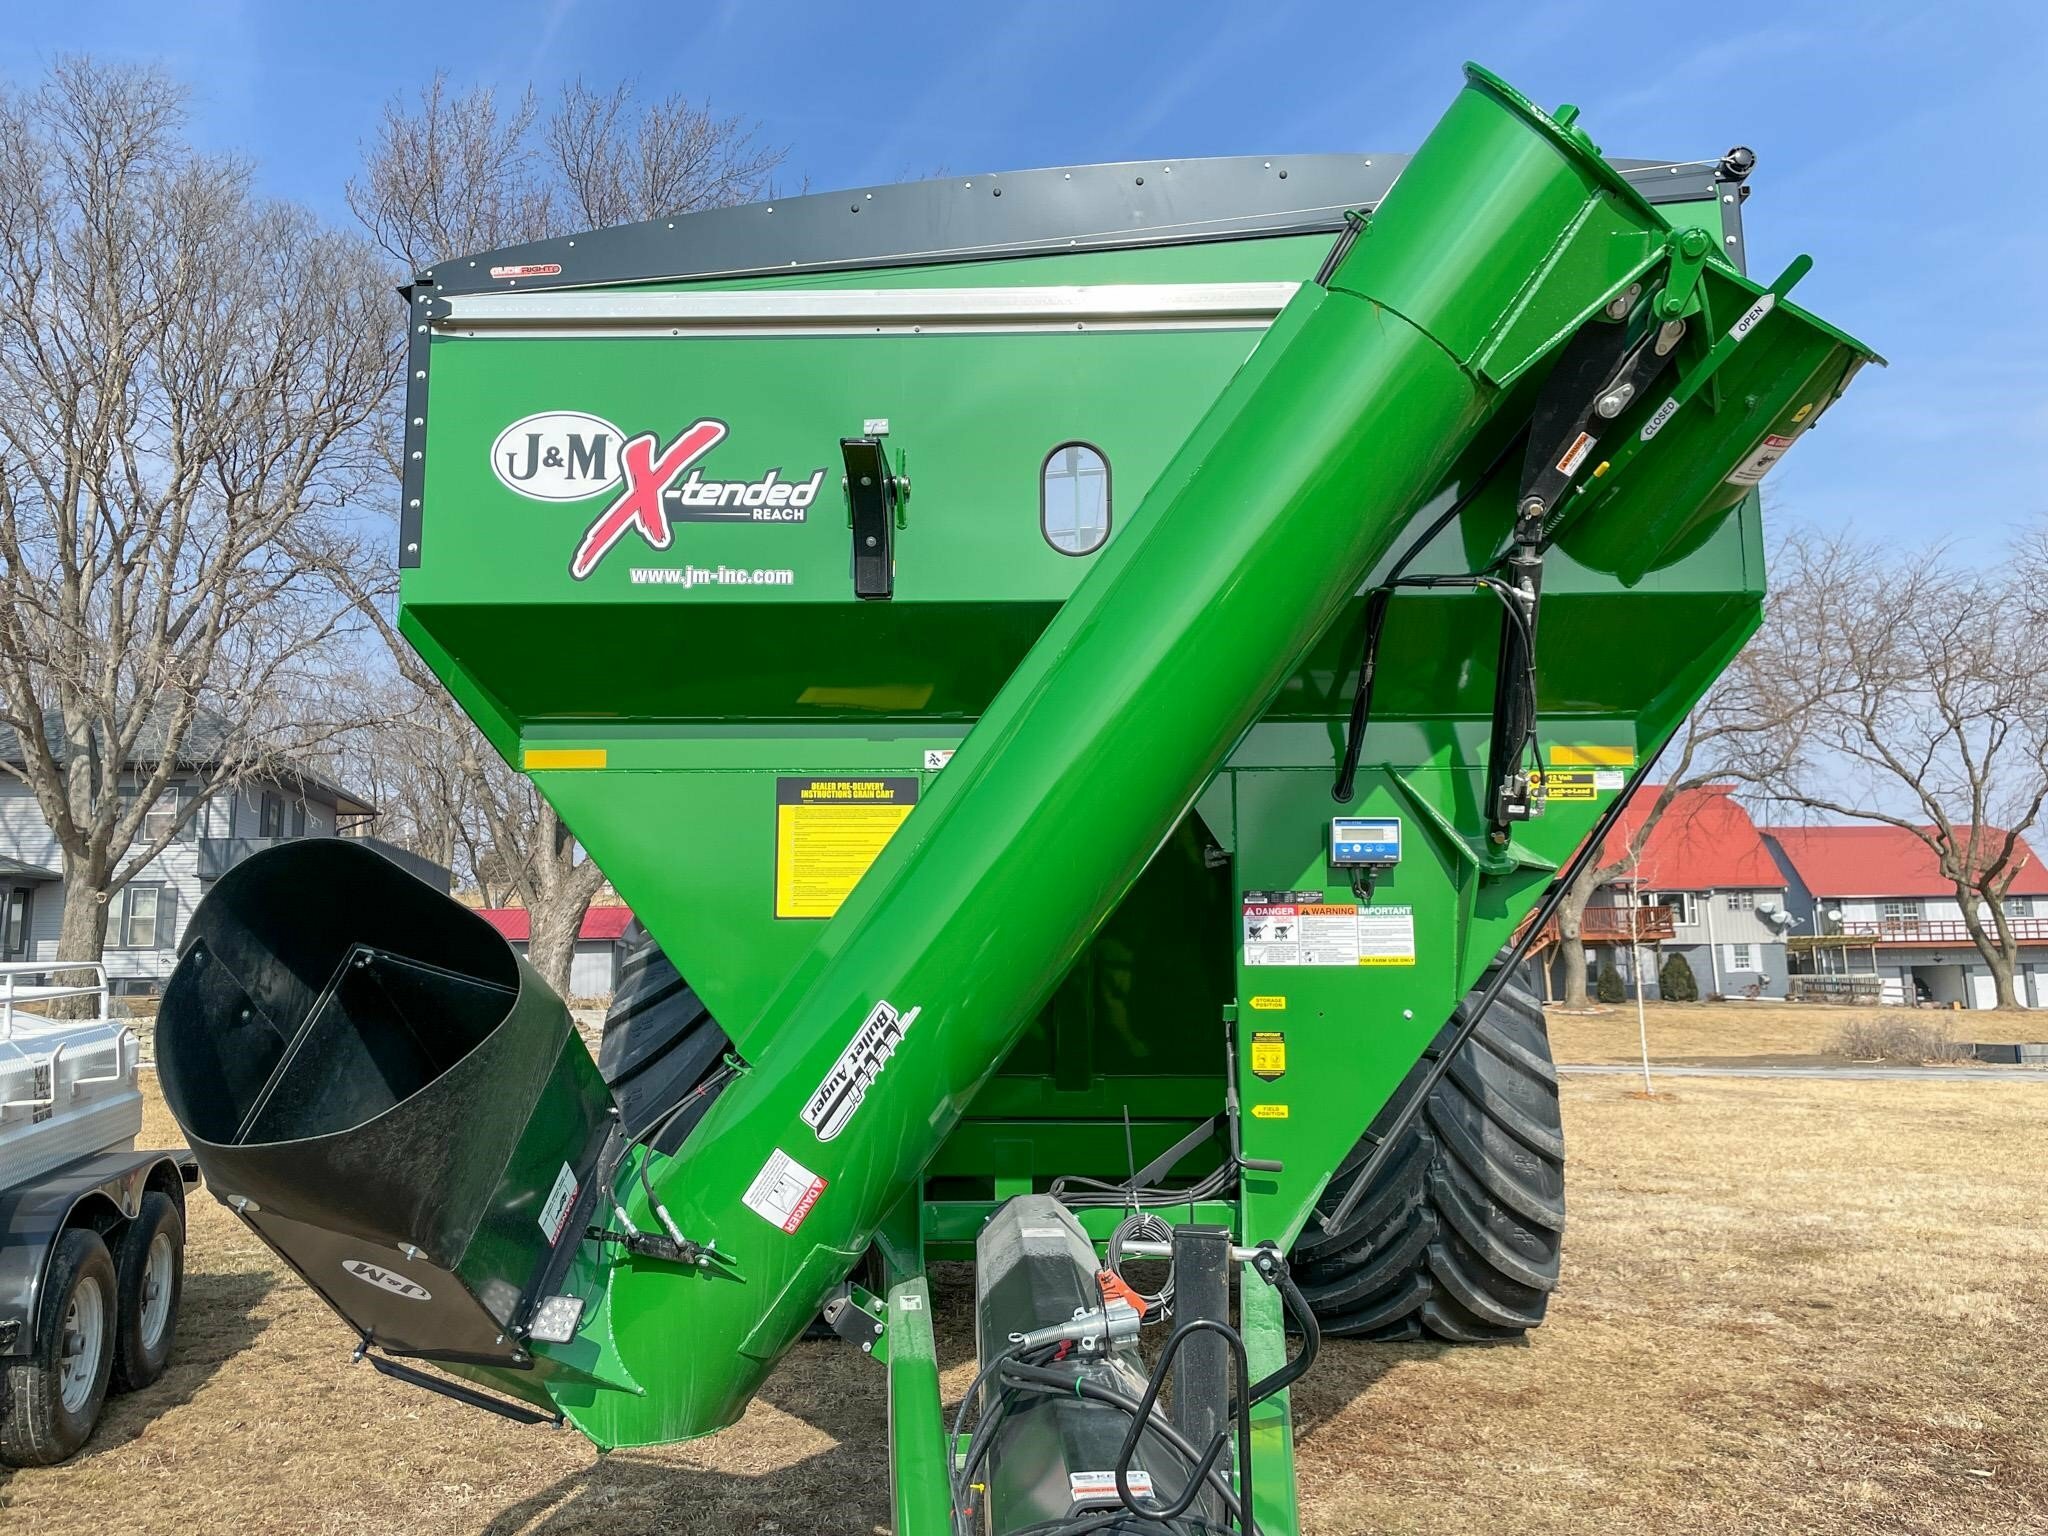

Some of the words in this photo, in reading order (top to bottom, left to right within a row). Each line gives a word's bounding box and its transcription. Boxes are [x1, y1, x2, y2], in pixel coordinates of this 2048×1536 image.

[1738, 305, 1764, 332] OPEN
[1644, 401, 1675, 436] CLOSED
[506, 432, 615, 481] J&M
[752, 508, 804, 521] REACH
[630, 566, 793, 588] www.jm-inc.com
[801, 790, 852, 799] INSTRUCTIONS
[853, 790, 875, 799] GRAIN
[876, 790, 895, 799] CART
[811, 782, 836, 790] DEALER
[837, 782, 885, 790] PRE-DELIVERY
[1255, 907, 1294, 916] DANGER
[1311, 907, 1355, 916] WARNING
[1358, 906, 1412, 915] IMPORTANT
[847, 1009, 889, 1065] Bullet
[810, 1064, 848, 1121] Auger
[785, 1186, 820, 1232] DANGER
[351, 1262, 428, 1298] J&M
